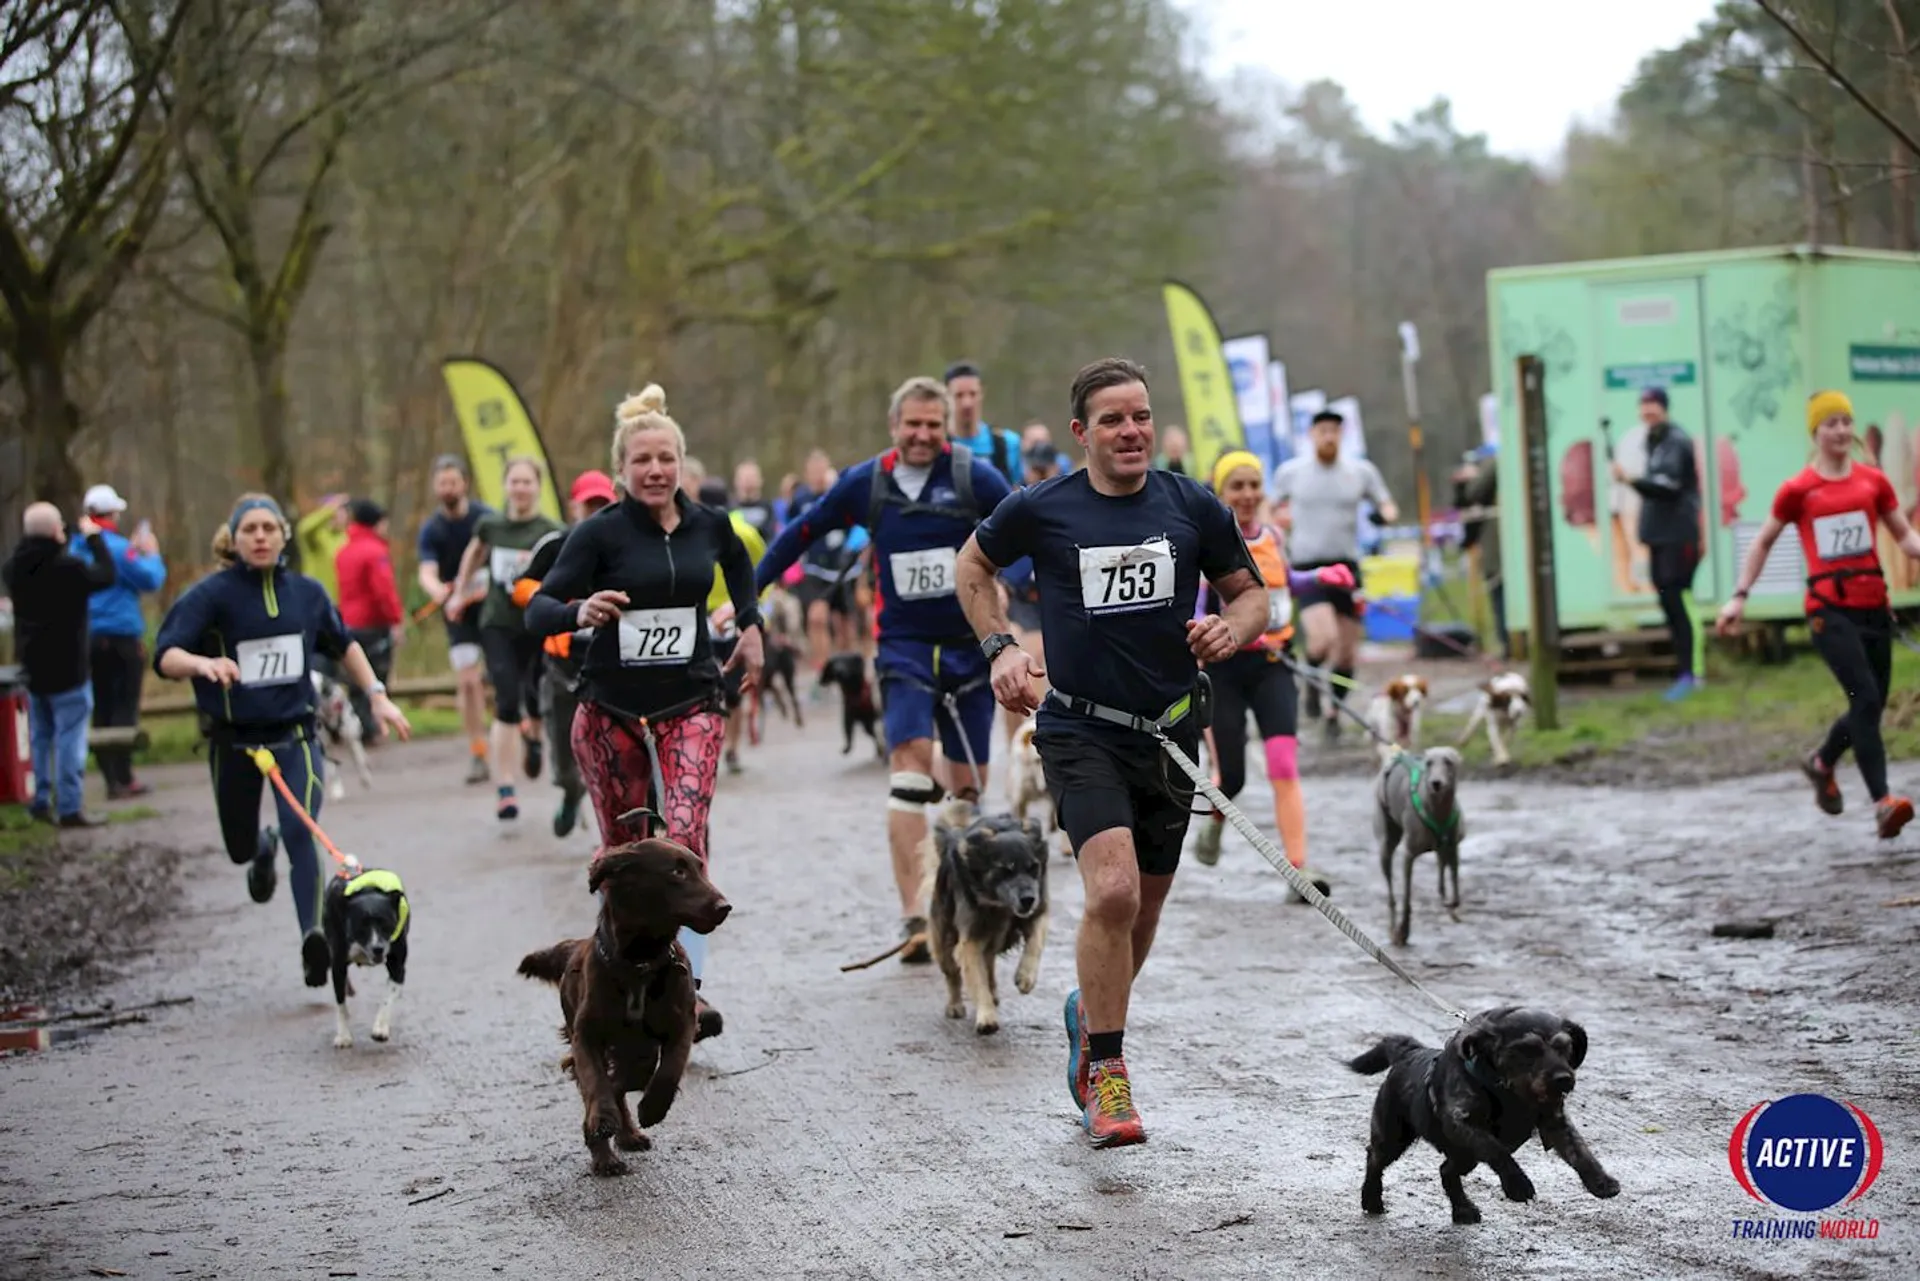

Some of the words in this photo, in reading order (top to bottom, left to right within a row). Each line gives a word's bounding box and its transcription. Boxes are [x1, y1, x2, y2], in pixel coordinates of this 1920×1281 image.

[1830, 525, 1864, 553] 727
[906, 563, 945, 592] 763
[1101, 562, 1156, 604] 753
[637, 626, 681, 657] 722
[259, 652, 288, 679] 771
